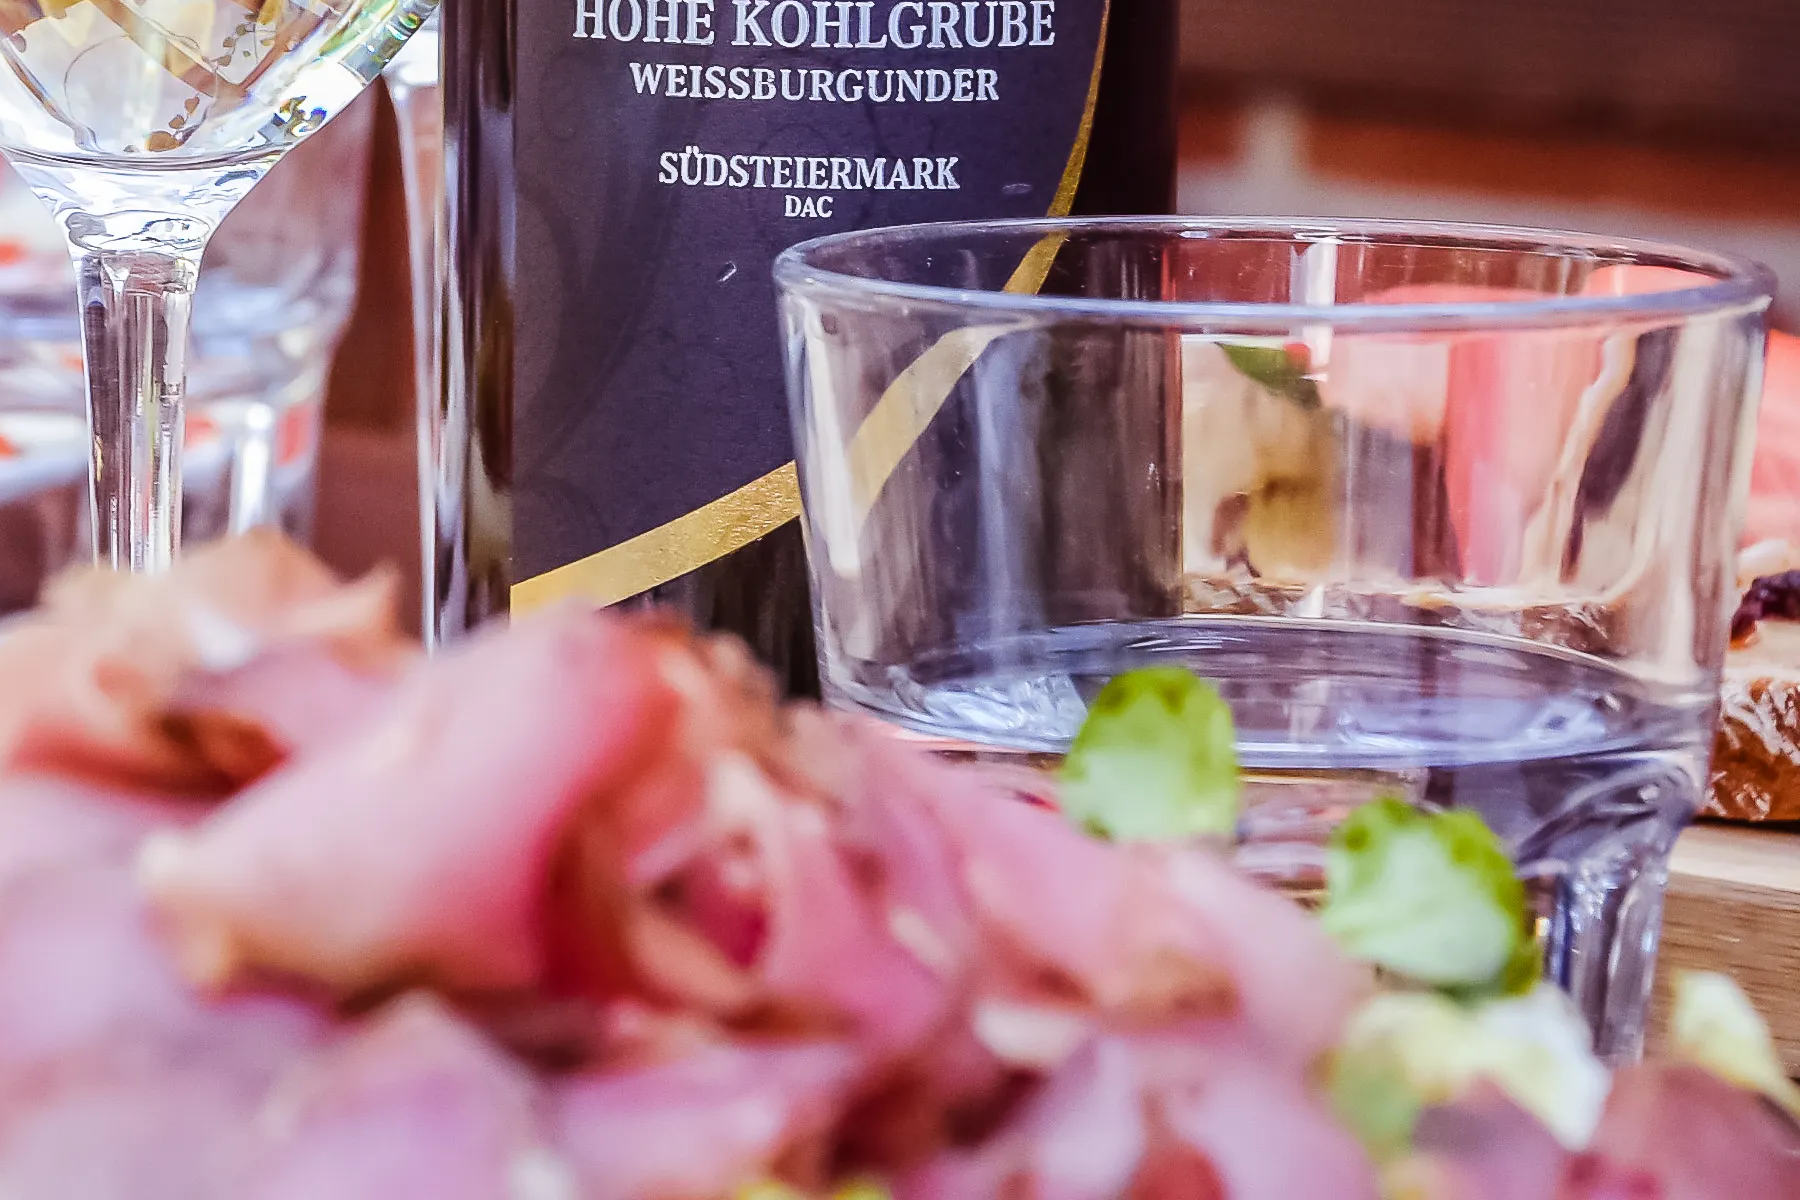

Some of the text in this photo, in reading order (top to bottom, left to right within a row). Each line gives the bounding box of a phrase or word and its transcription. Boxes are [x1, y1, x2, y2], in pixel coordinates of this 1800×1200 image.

[731, 0, 1056, 49] KOHLGRUBE
[629, 62, 1000, 103] WEISSBURGUNDER
[658, 145, 961, 190] SÜDSTEIERMARK
[784, 194, 834, 218] DAC
